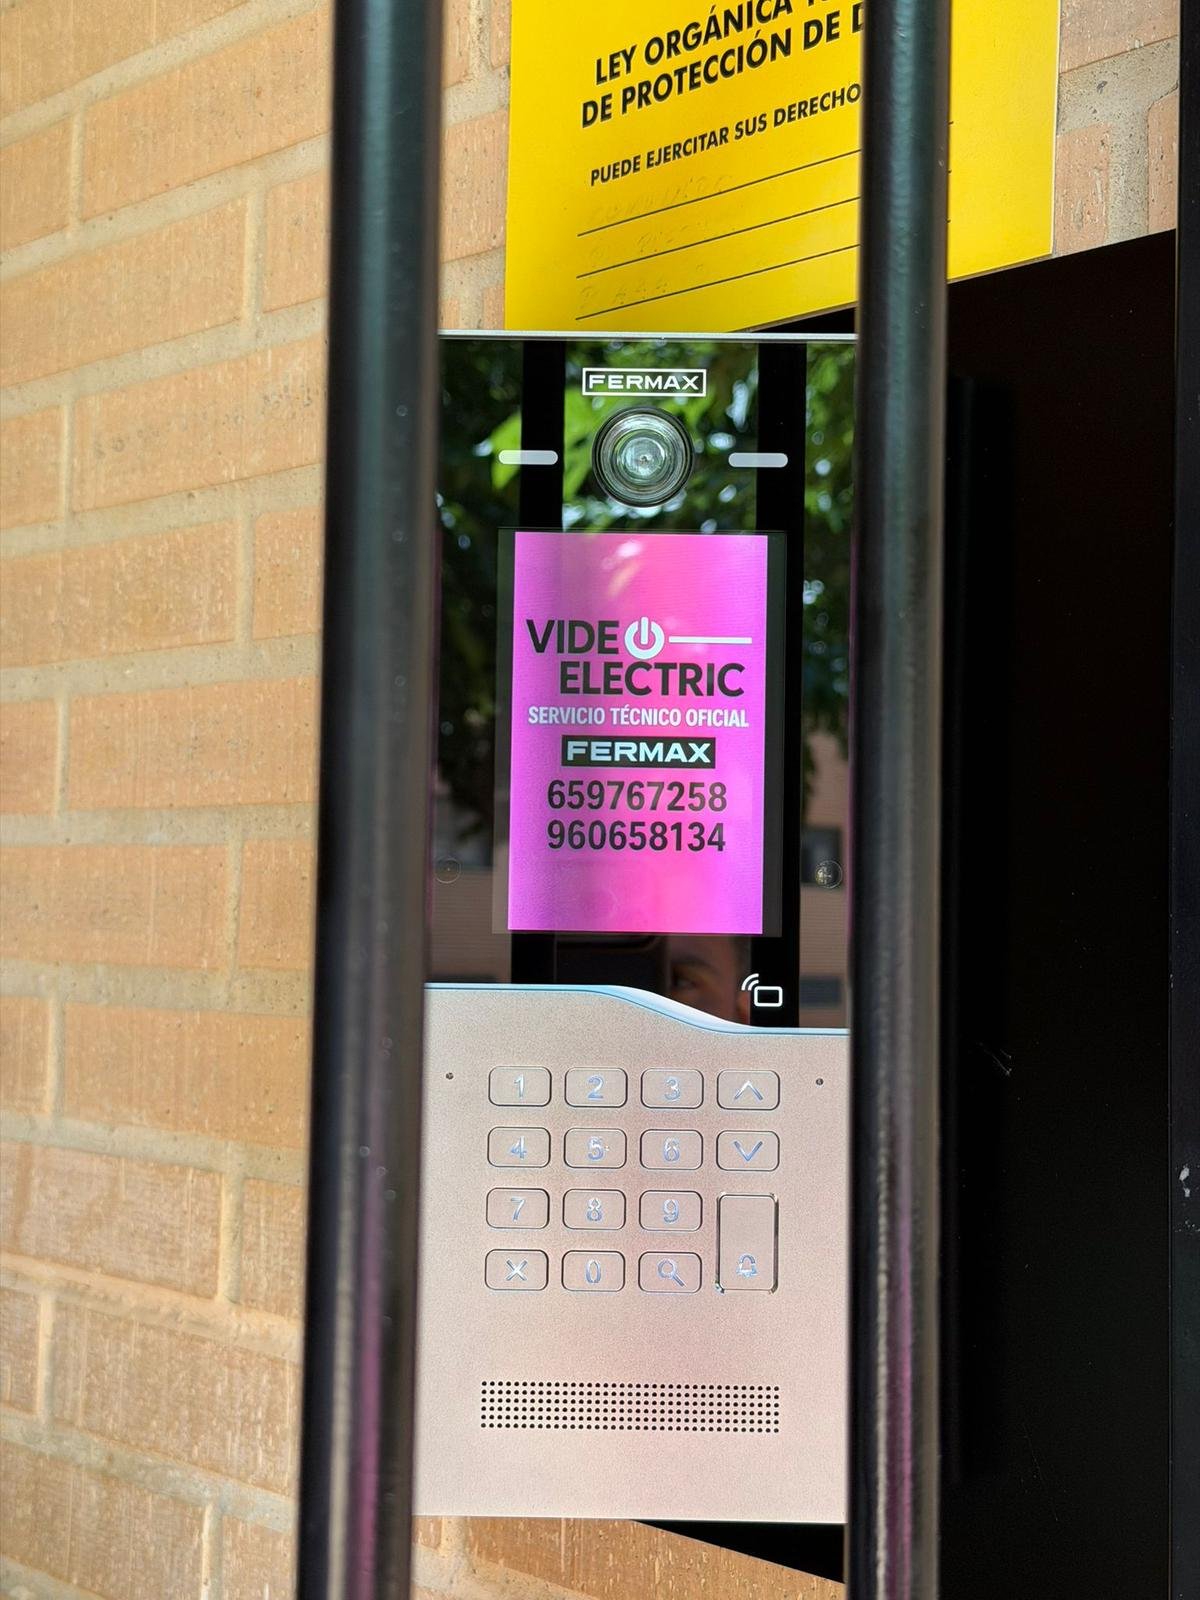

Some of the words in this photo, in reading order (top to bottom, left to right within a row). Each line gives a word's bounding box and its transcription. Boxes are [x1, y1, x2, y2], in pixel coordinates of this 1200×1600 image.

[595, 44, 637, 86] LEY
[644, 0, 793, 66] ORGÁNICA
[581, 93, 613, 129] DE
[621, 27, 792, 115] PROTECCIÓN
[803, 10, 840, 51] DE
[590, 154, 641, 187] PUEDE
[646, 126, 729, 170] EJERCITAR
[734, 113, 768, 141] SUS
[773, 83, 862, 128] DERECHO
[588, 374, 700, 391] FERMAX
[559, 661, 746, 697] ELECTRIC
[528, 706, 606, 725] SERVICIO
[610, 704, 681, 727] TÉCNICO
[686, 708, 749, 728] OFICIAL
[567, 741, 712, 764] FERMAX
[547, 780, 728, 812] 659767258
[547, 819, 727, 852] 960658134
[513, 1074, 525, 1099] 1
[587, 1075, 604, 1100] 2
[664, 1076, 681, 1102] 3
[510, 1135, 528, 1160] 4
[587, 1136, 604, 1162] 5
[663, 1137, 680, 1163] 6
[510, 1197, 526, 1222] 7
[586, 1198, 603, 1223] 8
[662, 1199, 680, 1224] 9
[585, 1259, 602, 1285] 0
